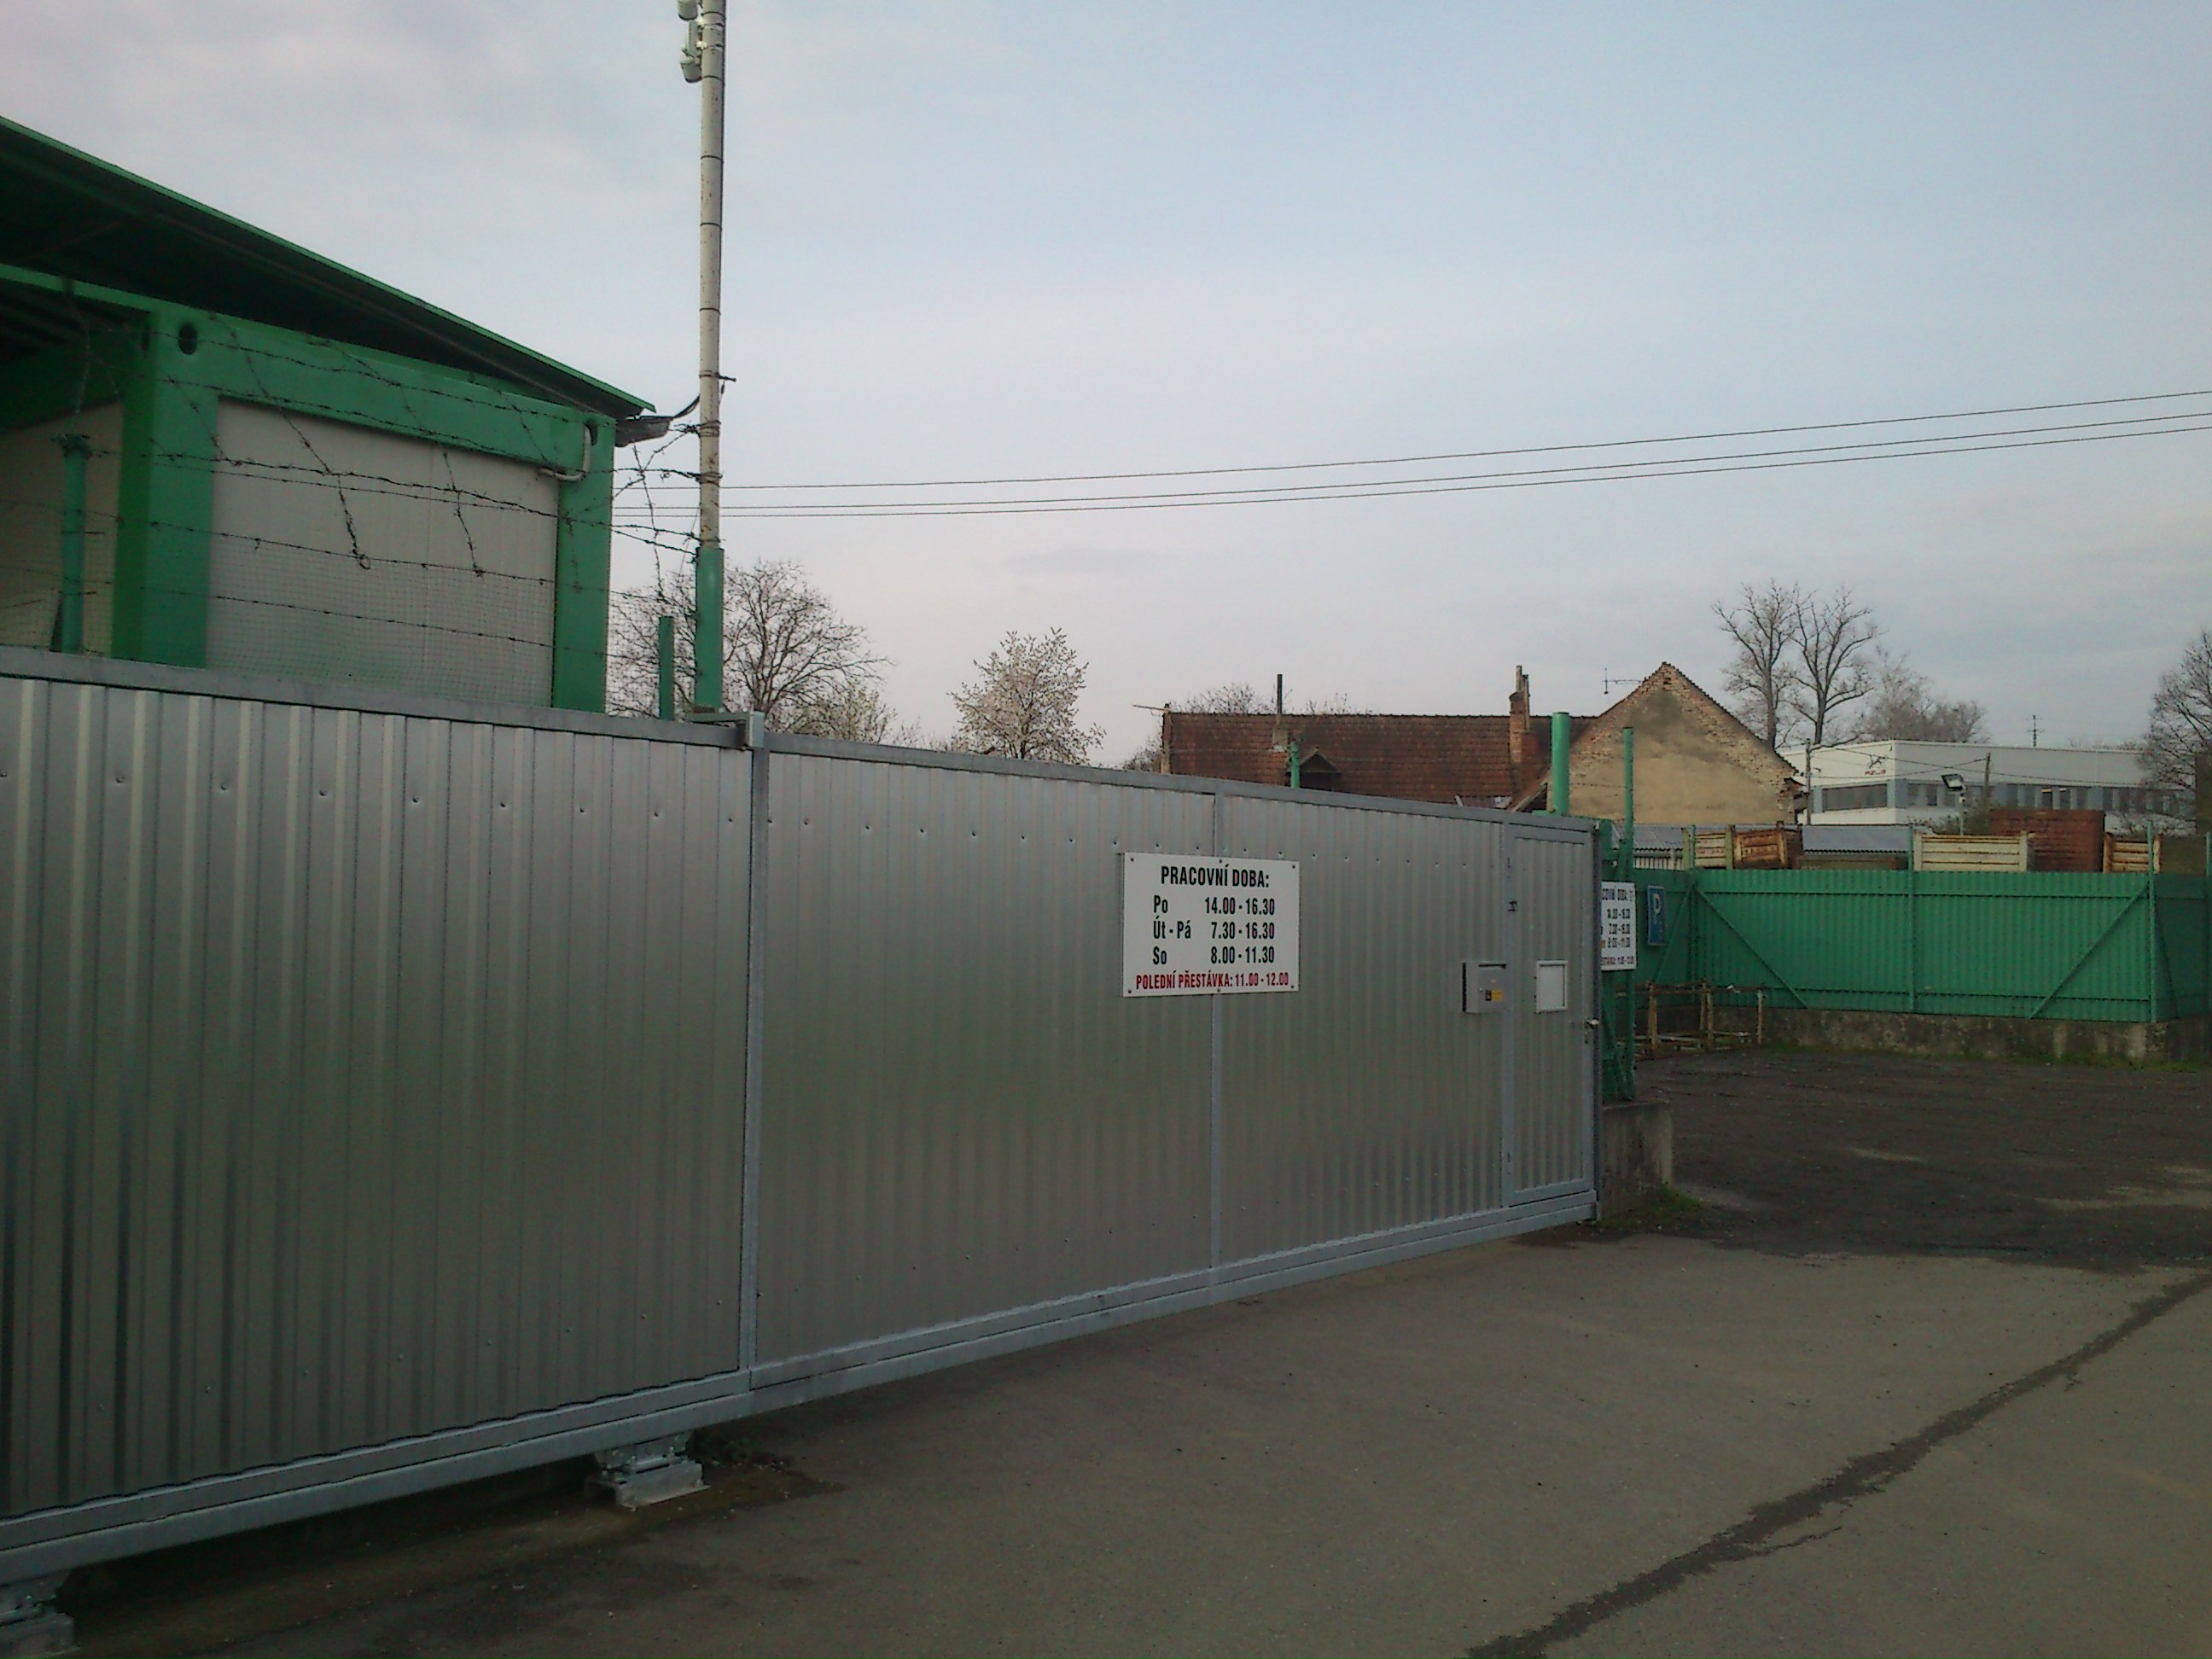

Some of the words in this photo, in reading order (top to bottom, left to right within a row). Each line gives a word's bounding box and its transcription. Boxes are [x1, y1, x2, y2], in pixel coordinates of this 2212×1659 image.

[1161, 864, 1230, 887] PRACOVNÍ
[1231, 868, 1270, 888] DOBA:
[1153, 894, 1169, 914] Po
[1653, 893, 1662, 924] P
[1153, 916, 1167, 940] Út
[1176, 919, 1191, 940] Pá
[1152, 946, 1167, 965] So
[1136, 970, 1177, 990] POLEDNÍ
[1178, 969, 1233, 988] PŘESTÁVKA:
